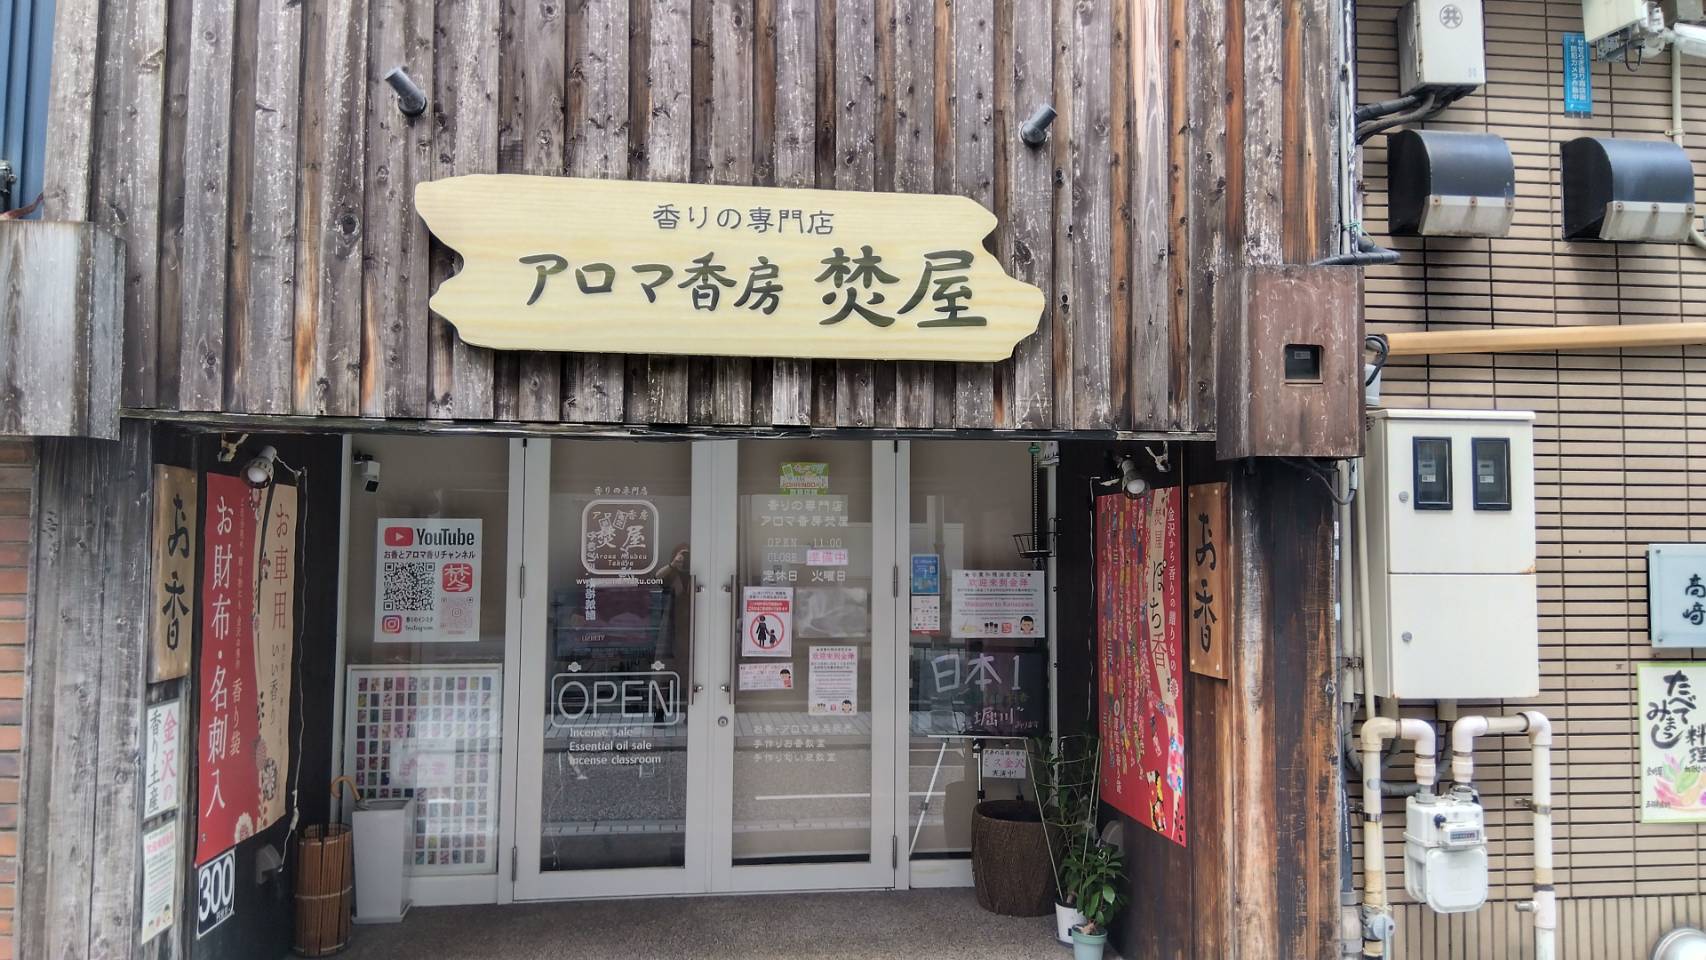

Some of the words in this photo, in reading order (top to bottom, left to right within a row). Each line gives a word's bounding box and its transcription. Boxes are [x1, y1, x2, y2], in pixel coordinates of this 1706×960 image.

[652, 203, 835, 236] 香りの専門店
[518, 250, 785, 316] アロマ香房
[813, 244, 988, 329] 焚屋
[591, 509, 649, 521] アロ香房
[767, 499, 845, 513] 香りの専門店
[416, 527, 475, 546] YouTube
[767, 537, 799, 547] OPEN
[767, 552, 798, 562] CLOSE
[162, 492, 190, 651] お香
[271, 502, 290, 631] お車用
[762, 569, 798, 582] 定休日
[811, 569, 846, 582] 火曜日
[1193, 511, 1217, 654] お香
[1149, 559, 1168, 669] ぽち香
[205, 495, 234, 818] お財布・名刺入
[558, 679, 674, 720] OPEN
[1663, 669, 1697, 724] たべて
[569, 727, 609, 737] Incense
[613, 727, 633, 737] sale
[569, 740, 613, 751] Essential
[615, 740, 629, 750] oil
[631, 741, 652, 750] sale
[147, 708, 162, 815] 香り土産
[159, 708, 177, 802] 金沢の
[569, 755, 608, 765] Incense
[610, 755, 662, 765] classroom
[199, 855, 233, 922] 300
